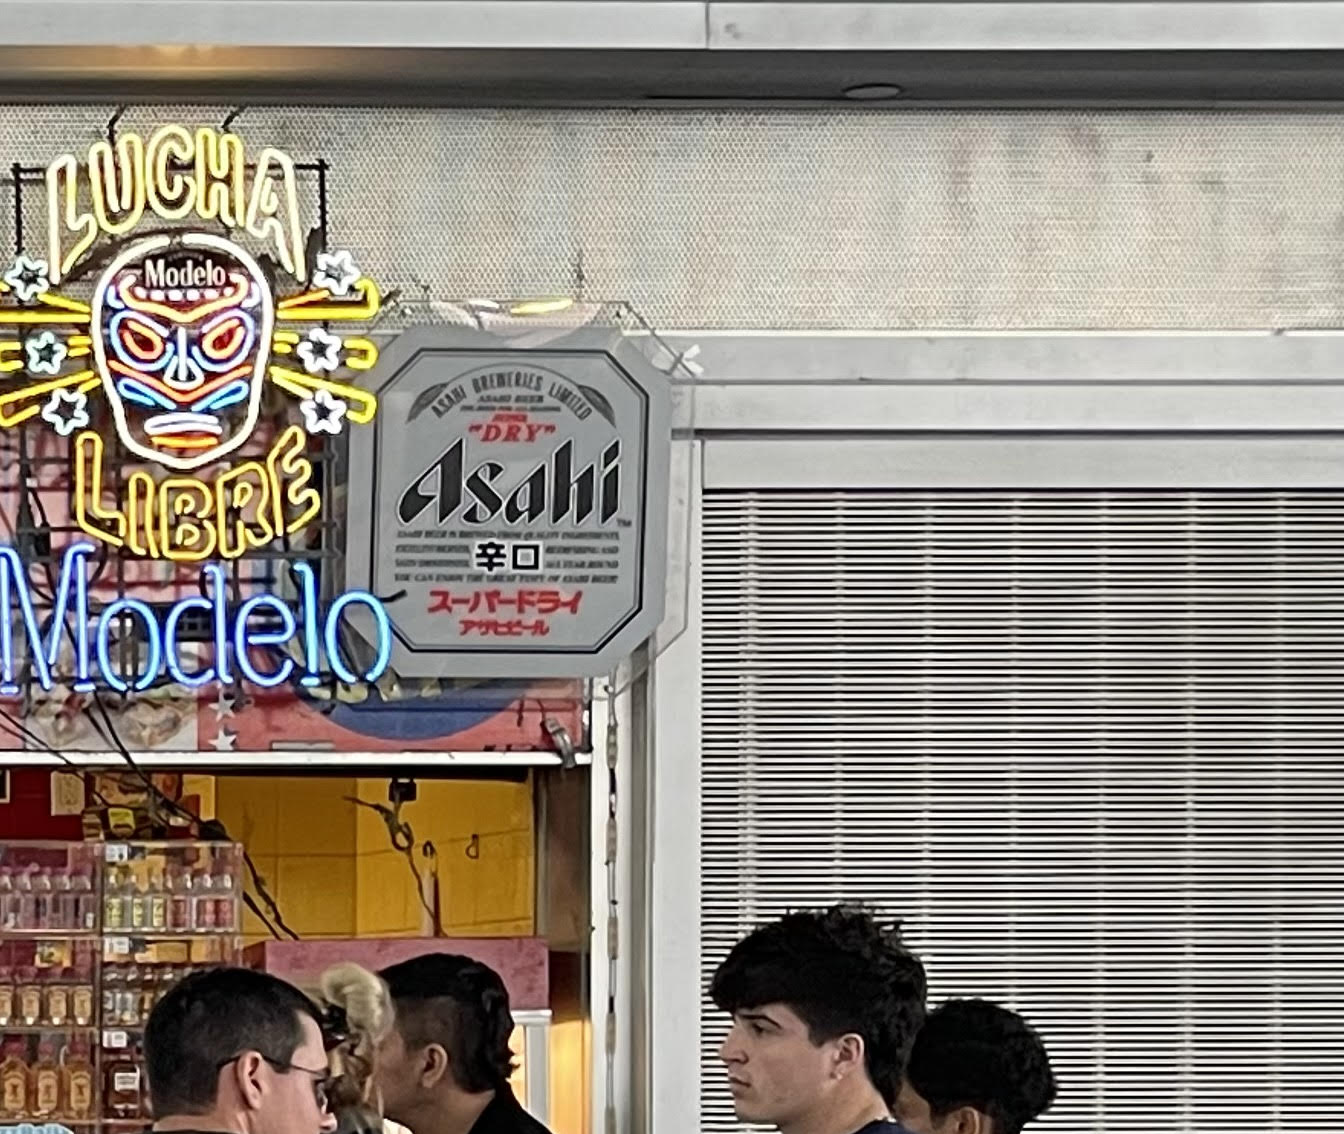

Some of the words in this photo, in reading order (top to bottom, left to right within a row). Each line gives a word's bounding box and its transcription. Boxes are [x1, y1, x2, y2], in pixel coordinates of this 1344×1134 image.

[45, 125, 308, 285] LUCHA
[144, 258, 226, 288] Modelo
[431, 385, 467, 419] ASAHI
[472, 371, 543, 394] BREWERIES
[548, 382, 593, 421] LIMITED
[76, 425, 320, 561] LIBRE
[397, 437, 621, 525] Asahi
[475, 541, 540, 572] 辛口
[427, 589, 583, 614] スーパードライ
